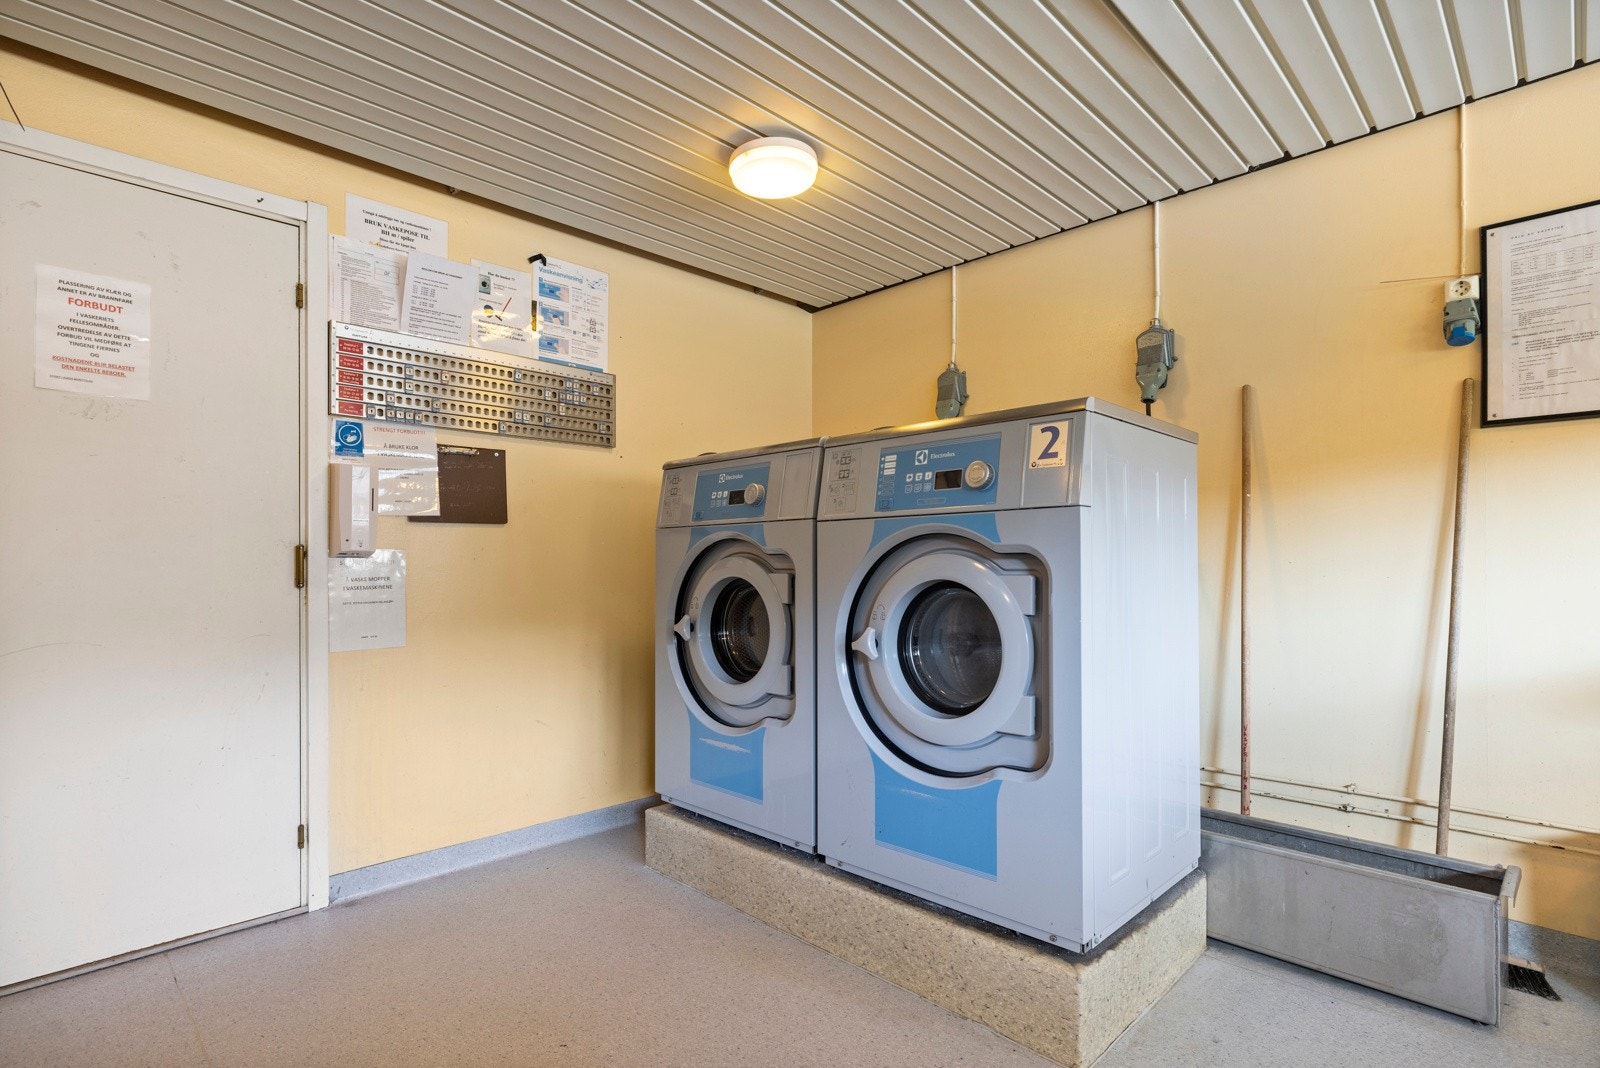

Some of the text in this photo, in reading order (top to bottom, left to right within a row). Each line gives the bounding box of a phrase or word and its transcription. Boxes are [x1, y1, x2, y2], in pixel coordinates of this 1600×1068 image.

[364, 218, 382, 228] BRUK
[384, 223, 419, 237] VASKEPOSE
[539, 266, 583, 284] Vaskeanvisning
[59, 279, 94, 290] PLASSERING
[98, 294, 133, 304] BRANNFARE
[68, 297, 124, 314] FORBUDT
[80, 313, 115, 322] VASKERIETS
[58, 324, 102, 336] OVERTREDELSE
[69, 318, 120, 331] FELLESOMRÅDER.
[69, 341, 95, 349] TINGENE
[94, 337, 122, 346] MEDFØRE
[52, 355, 93, 366] KOSTNADENE
[108, 363, 135, 372] BELASTET
[76, 366, 100, 374] ENKELTE
[1038, 426, 1060, 460] 2
